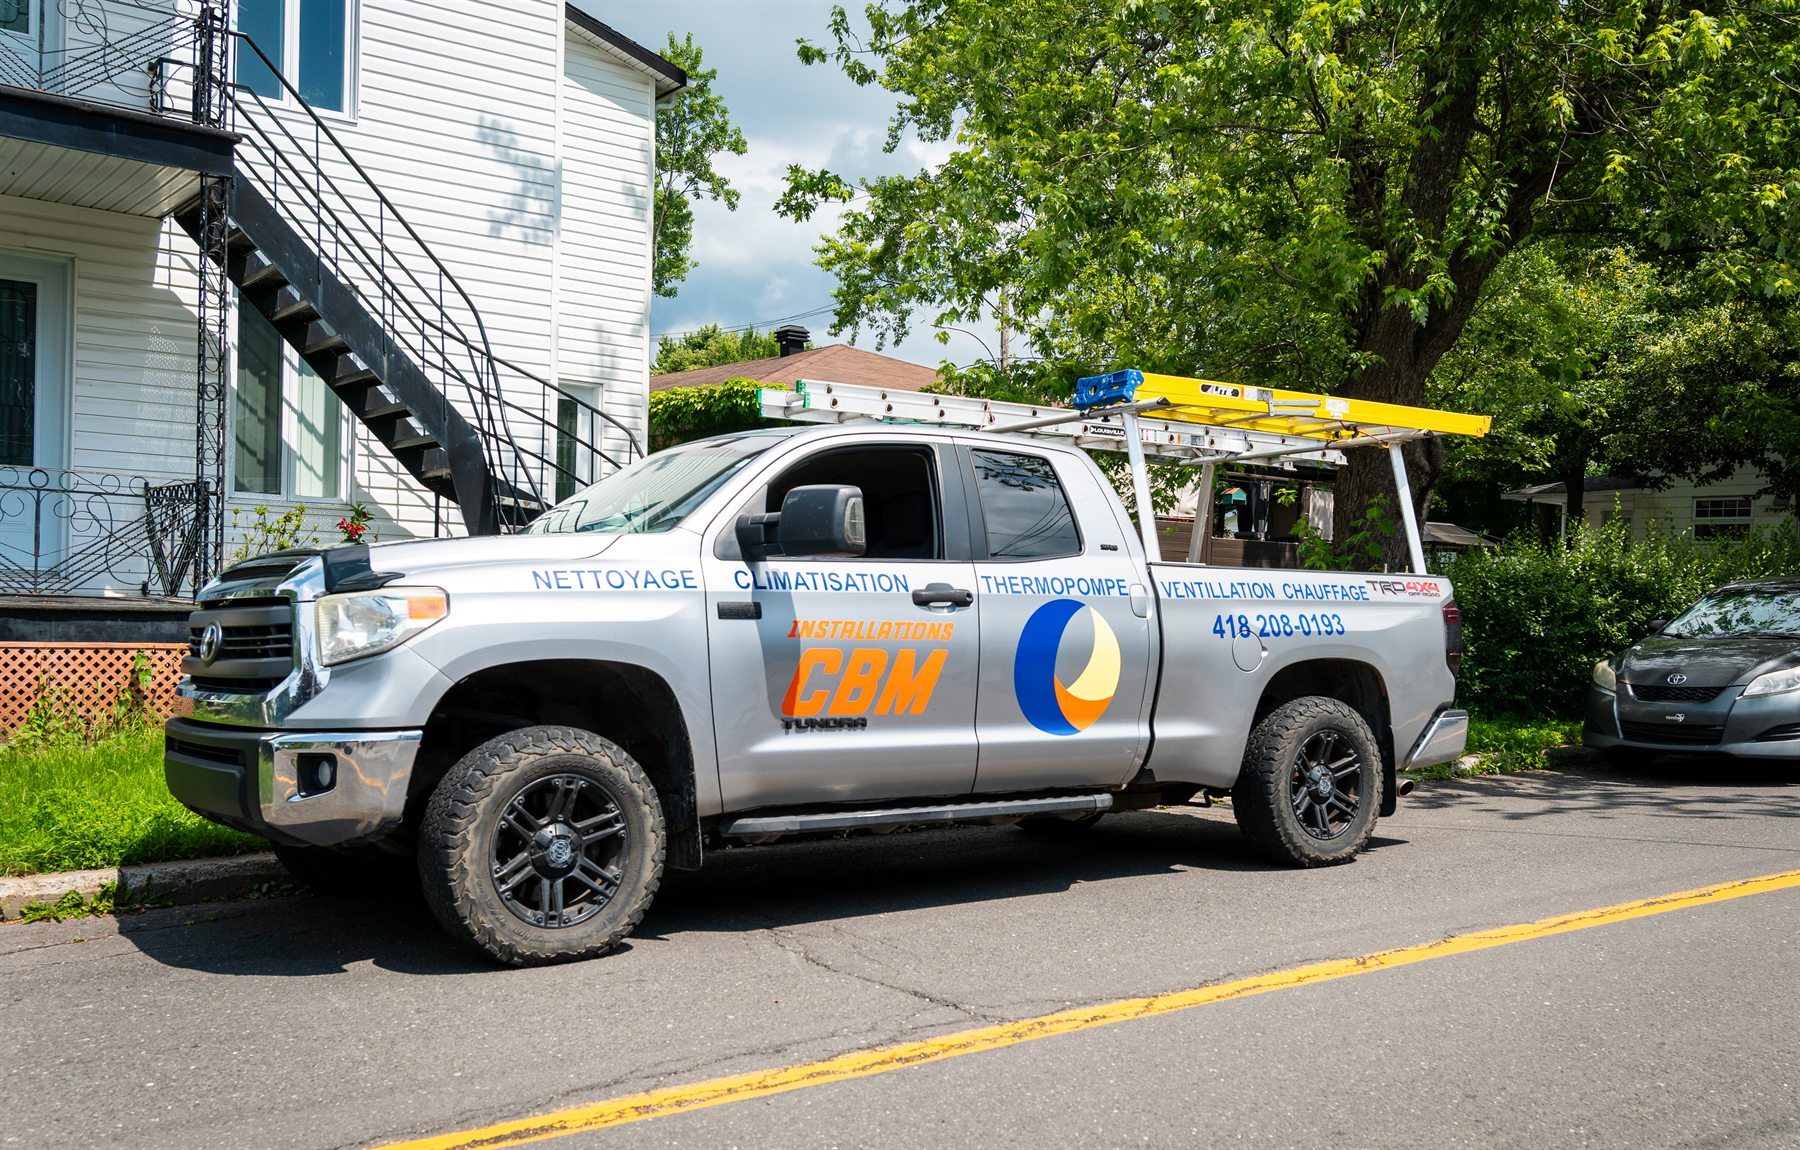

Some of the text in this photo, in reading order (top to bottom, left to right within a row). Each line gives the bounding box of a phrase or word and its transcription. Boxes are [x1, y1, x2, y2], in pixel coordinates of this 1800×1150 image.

[532, 569, 698, 590] NETTOYAGE
[734, 570, 909, 592] CLIMATISATION
[980, 575, 1129, 597] THERMOPOMPE
[1161, 581, 1370, 601] VENTILLATION CHAUFFAGE
[787, 619, 955, 641] INSTALLATIONS
[1213, 613, 1345, 639] 418 208-0193
[781, 648, 948, 716] CBM
[781, 717, 868, 731] TUNDRA
